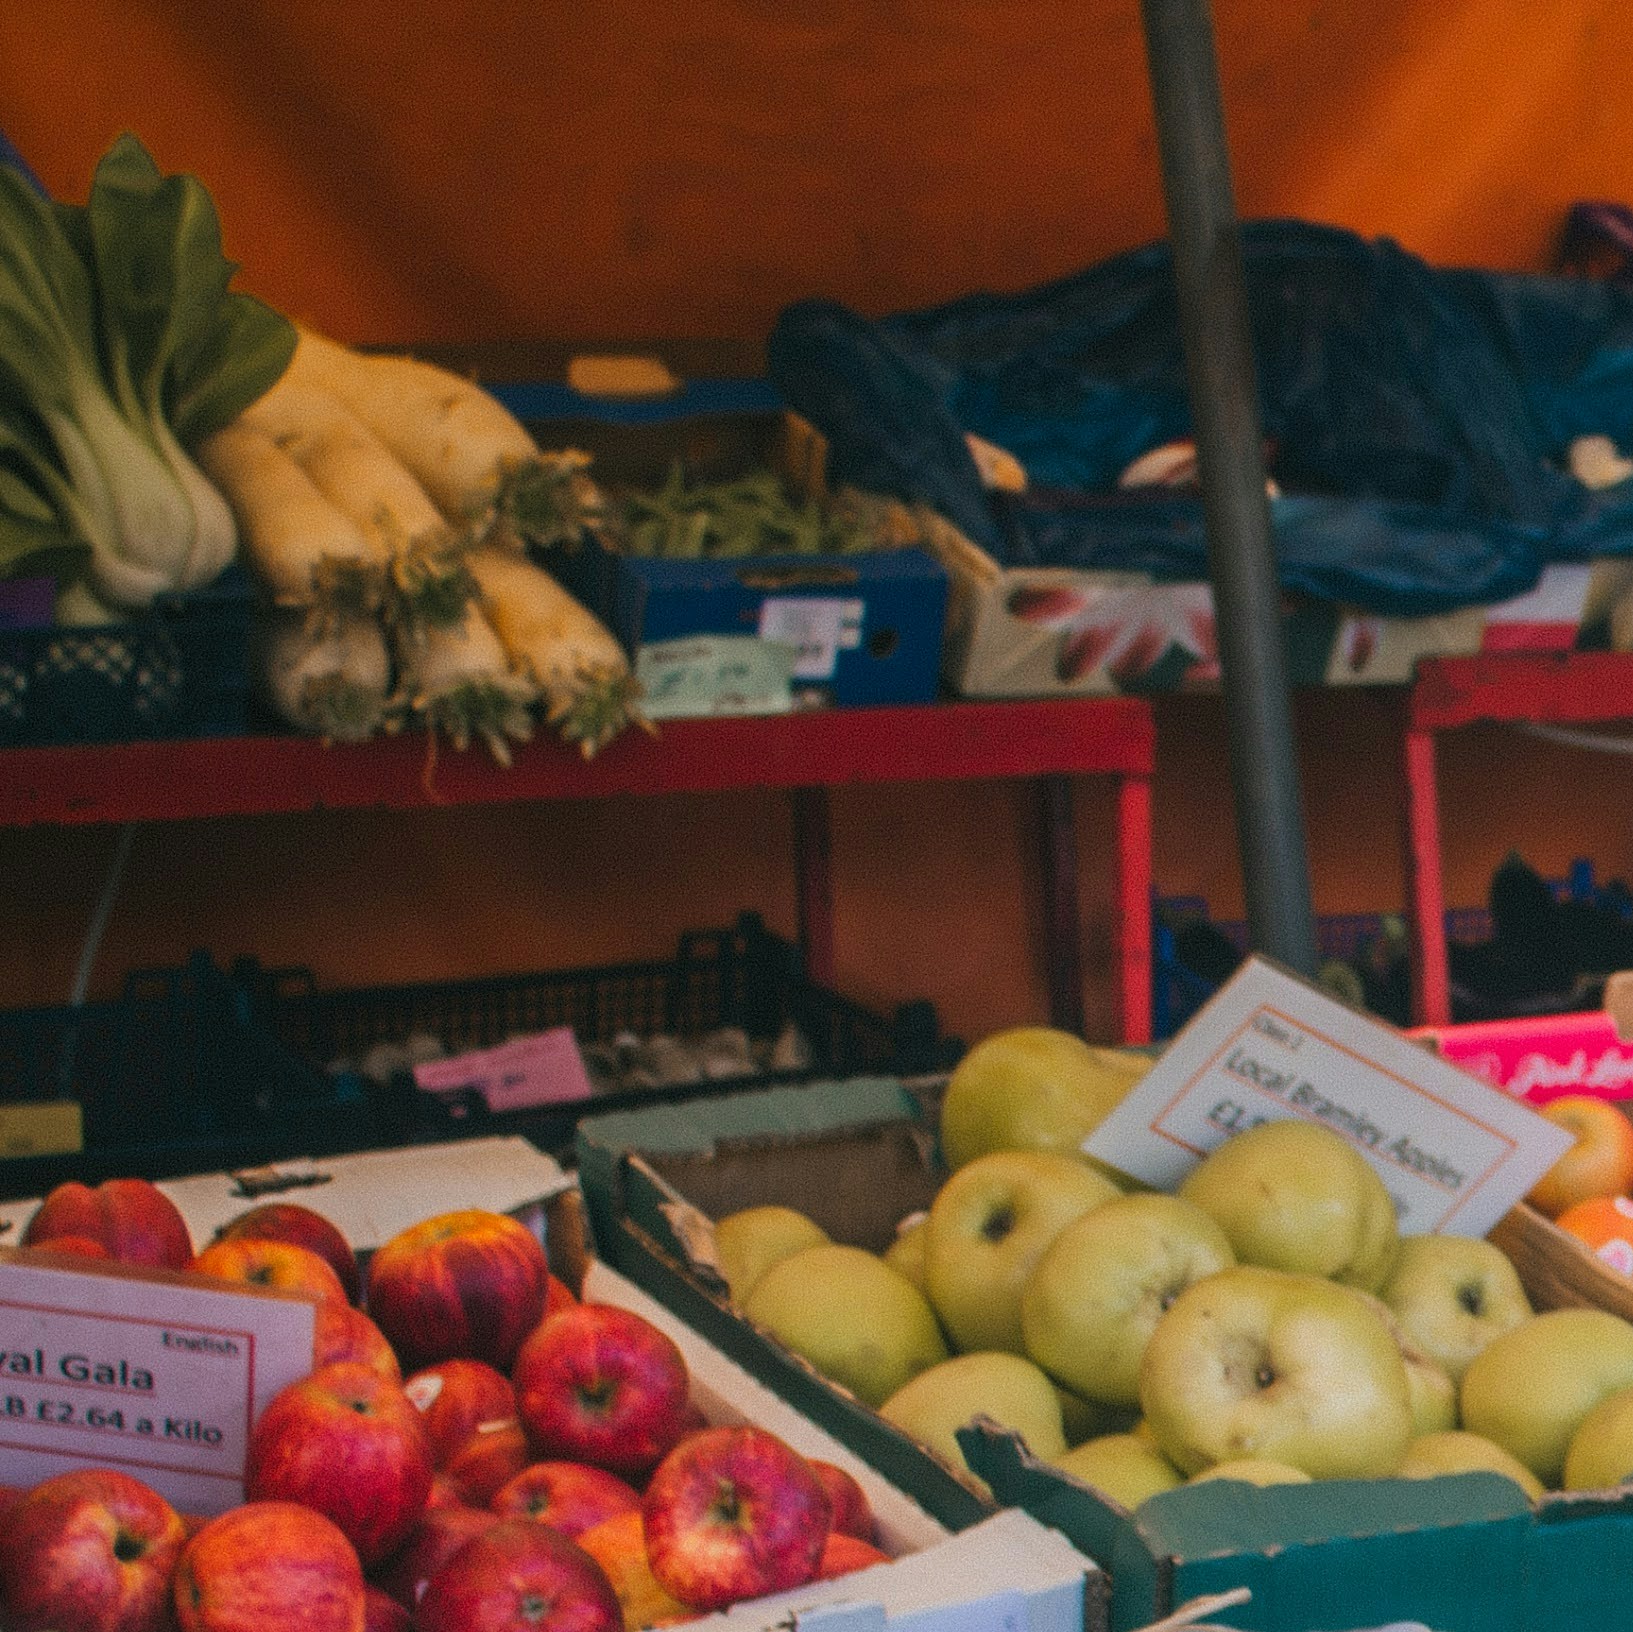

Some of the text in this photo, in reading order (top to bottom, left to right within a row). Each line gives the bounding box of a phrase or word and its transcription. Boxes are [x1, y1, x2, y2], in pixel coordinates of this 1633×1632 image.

[1225, 1048, 1467, 1192] Local Bramley Apples
[161, 1330, 239, 1354] English
[58, 1352, 154, 1391] Gala
[36, 1400, 125, 1430] £2.64
[135, 1417, 153, 1434] a
[163, 1416, 224, 1444] Kilo
